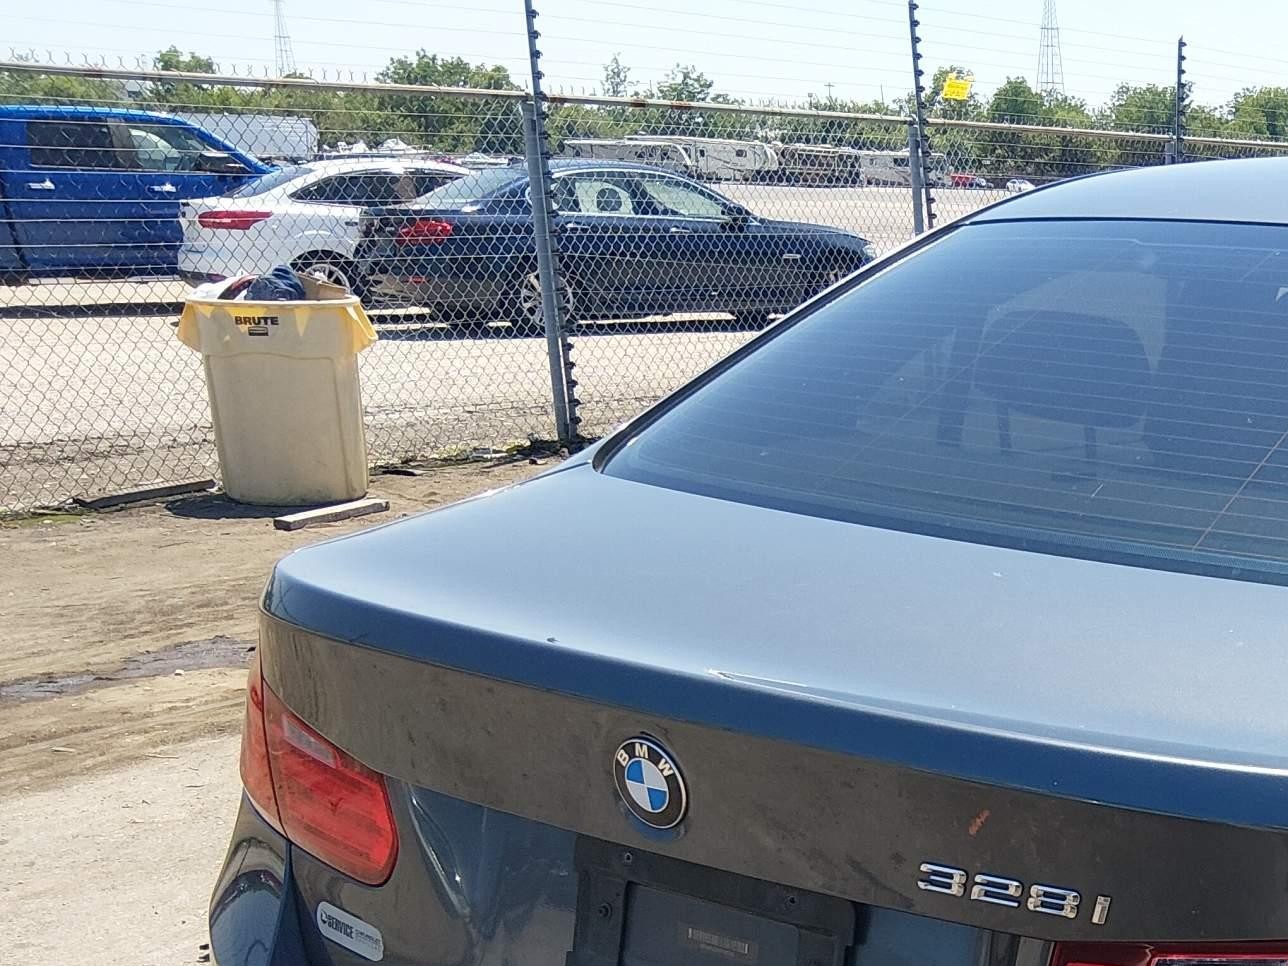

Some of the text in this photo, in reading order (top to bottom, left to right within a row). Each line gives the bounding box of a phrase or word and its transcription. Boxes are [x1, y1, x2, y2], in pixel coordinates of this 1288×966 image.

[234, 315, 280, 326] BRUTE
[617, 743, 674, 777] BMW
[917, 863, 1112, 925] 328i
